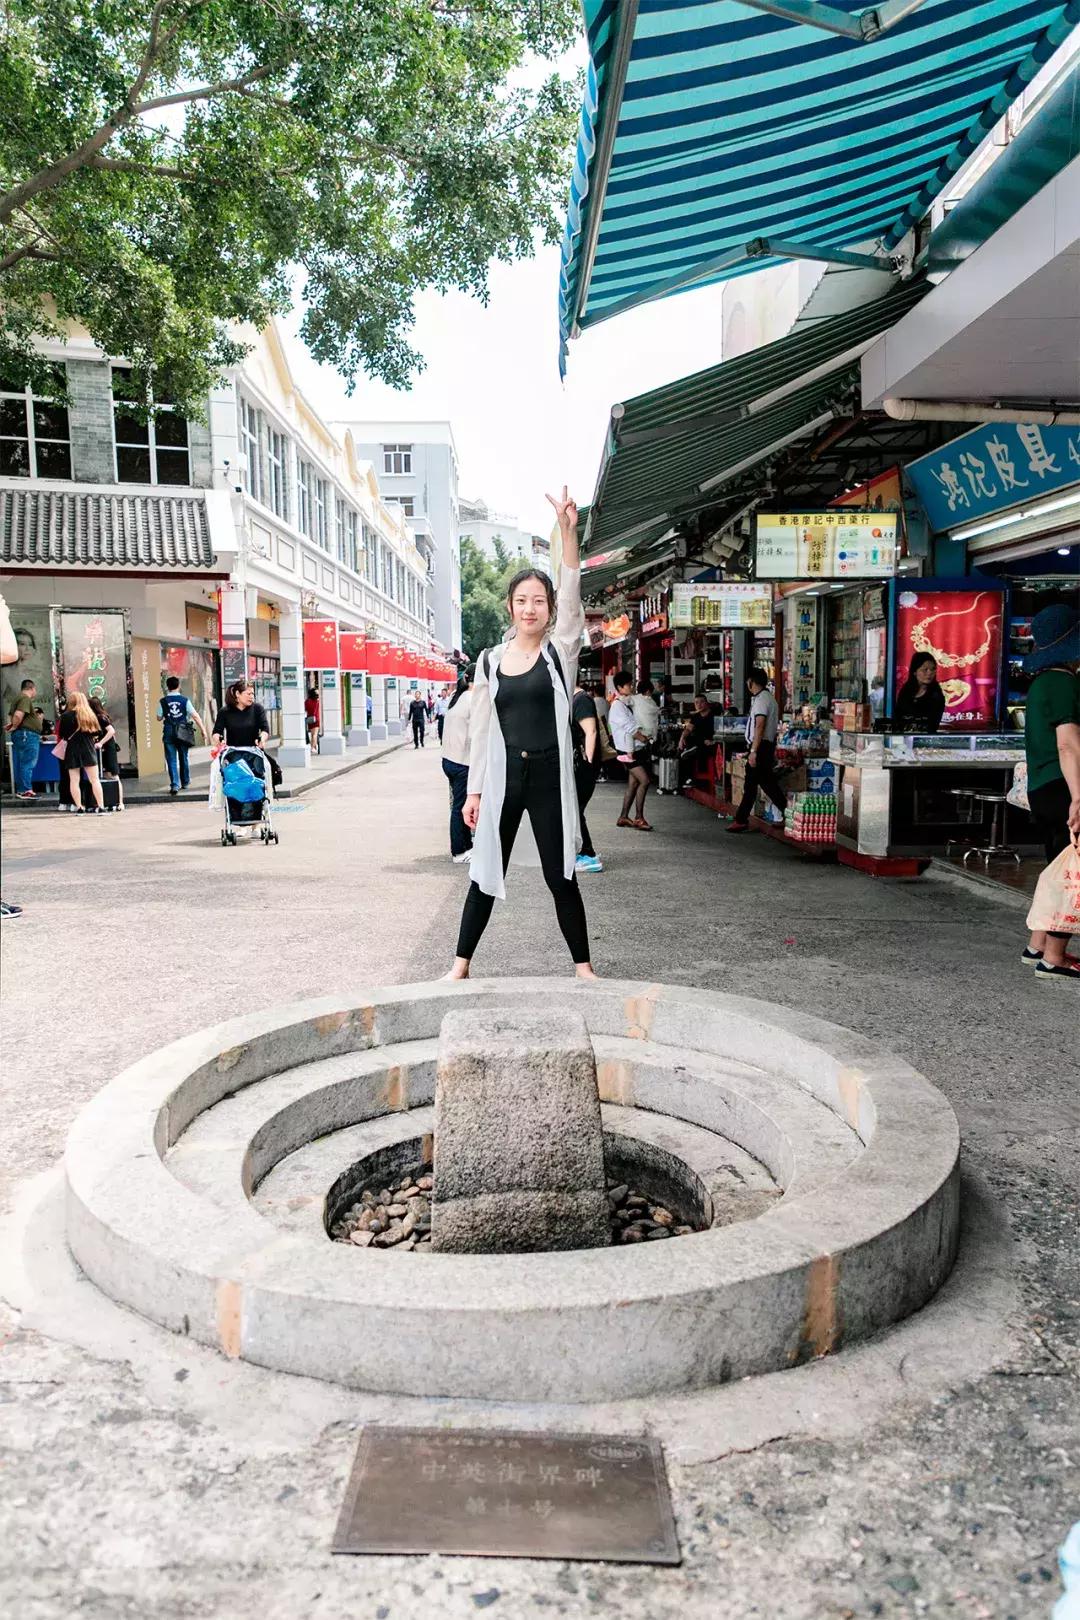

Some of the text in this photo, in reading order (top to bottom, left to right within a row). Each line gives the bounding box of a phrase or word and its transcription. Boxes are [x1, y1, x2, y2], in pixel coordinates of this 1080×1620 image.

[421, 1461, 605, 1488] 中英街界碑
